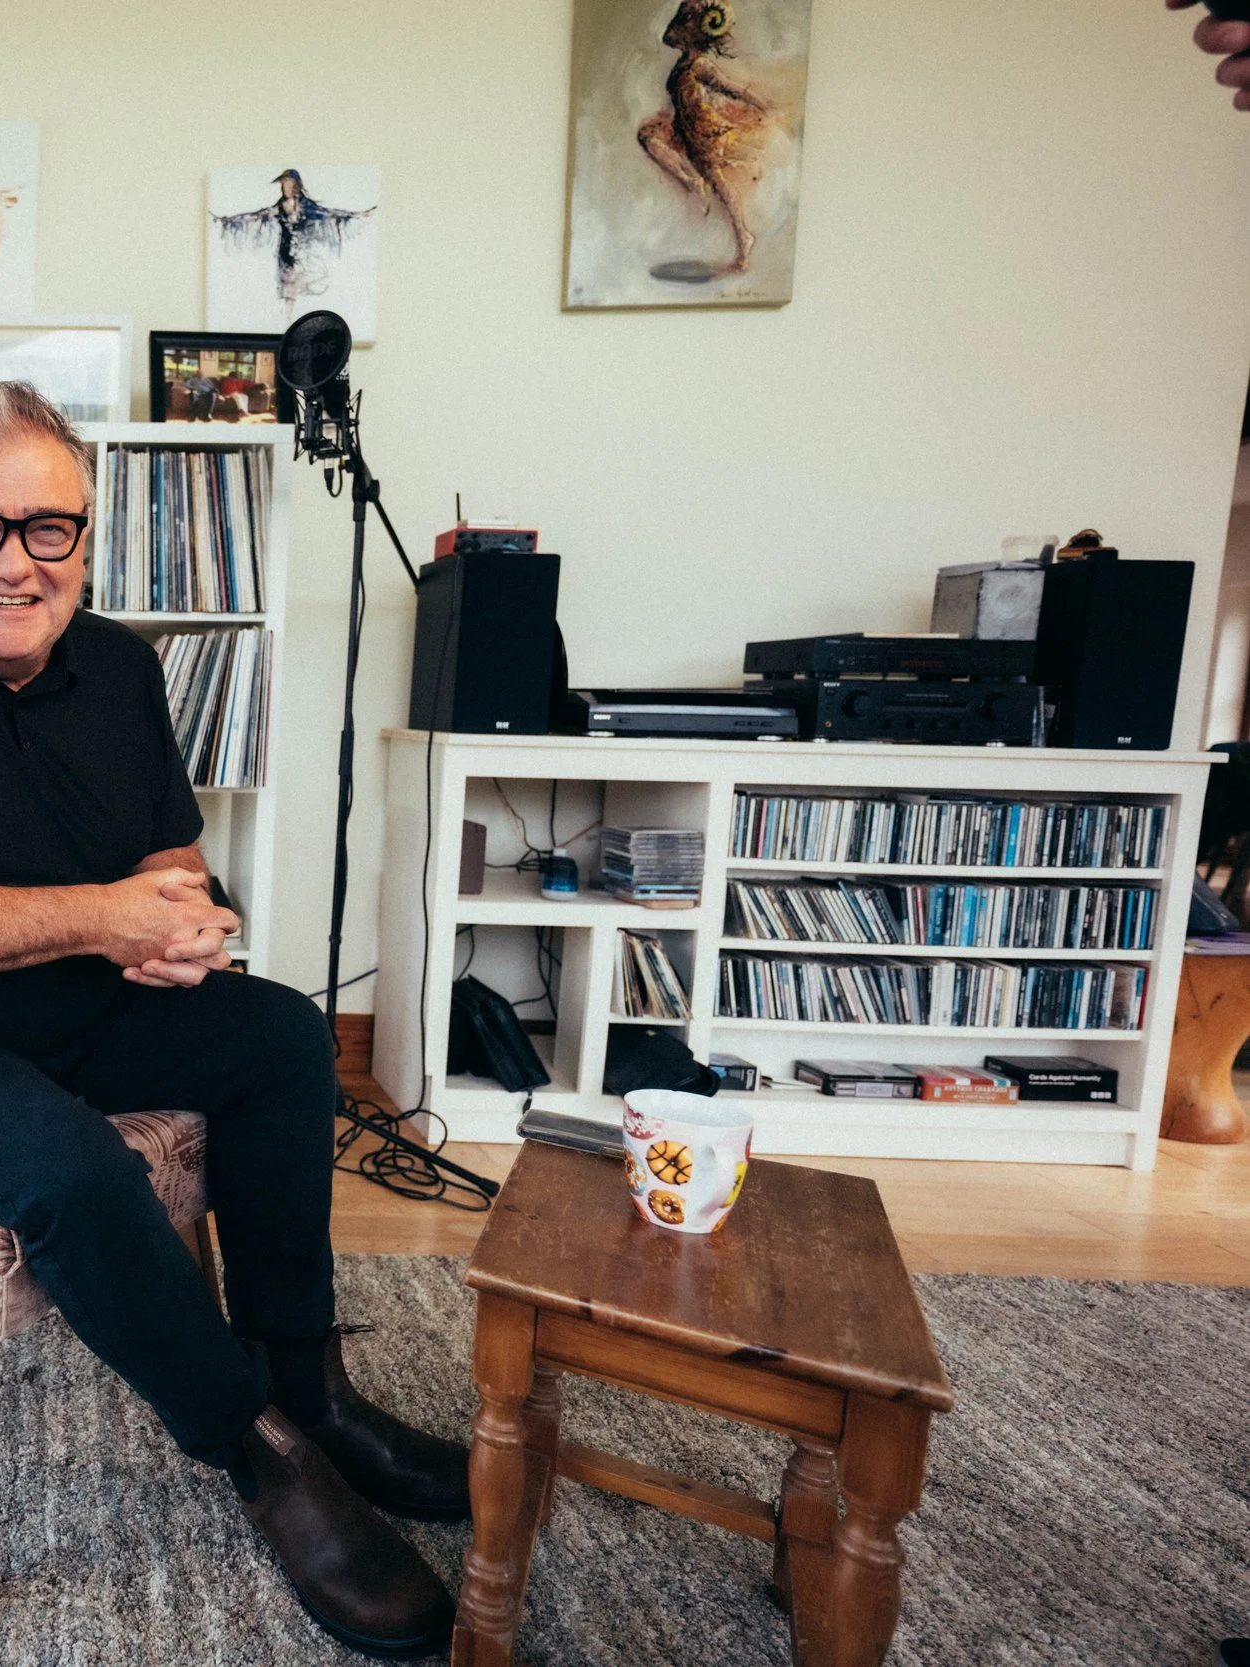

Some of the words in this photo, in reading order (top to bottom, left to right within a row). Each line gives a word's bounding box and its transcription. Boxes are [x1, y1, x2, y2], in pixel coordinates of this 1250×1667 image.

[1048, 1074, 1071, 1082] Against
[1072, 1075, 1102, 1083] Humanity
[259, 1414, 285, 1442] AUSTRALI
